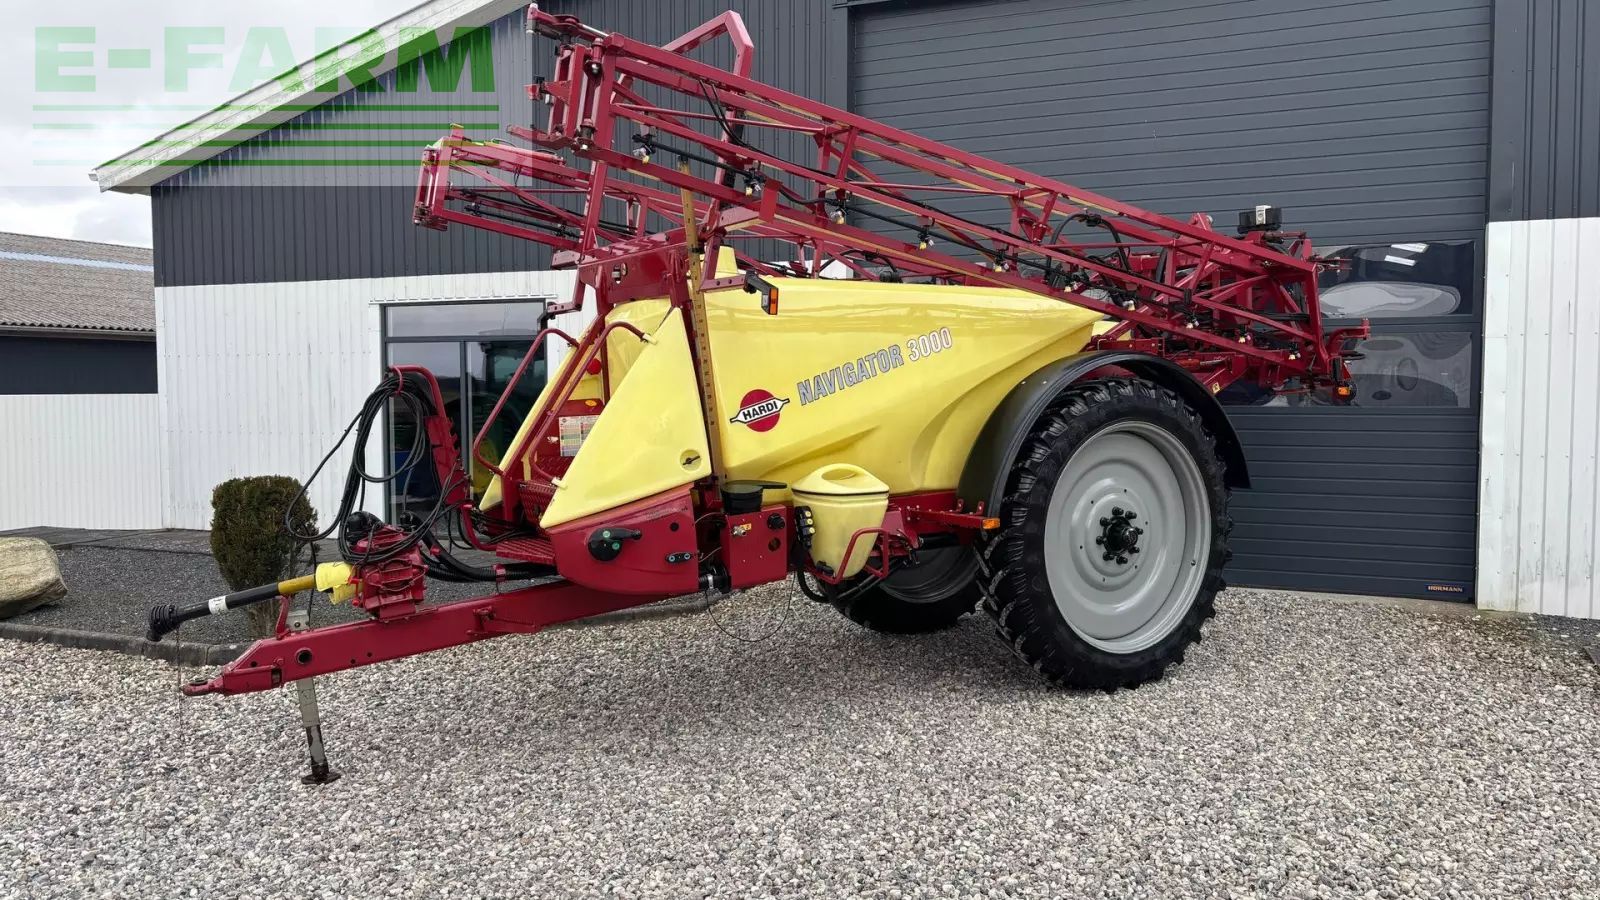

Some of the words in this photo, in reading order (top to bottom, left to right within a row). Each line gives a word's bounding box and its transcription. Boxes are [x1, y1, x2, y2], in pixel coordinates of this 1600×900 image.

[797, 344, 905, 406] NAVIGATOR
[907, 327, 953, 362] 3000
[742, 401, 779, 421] HARDI
